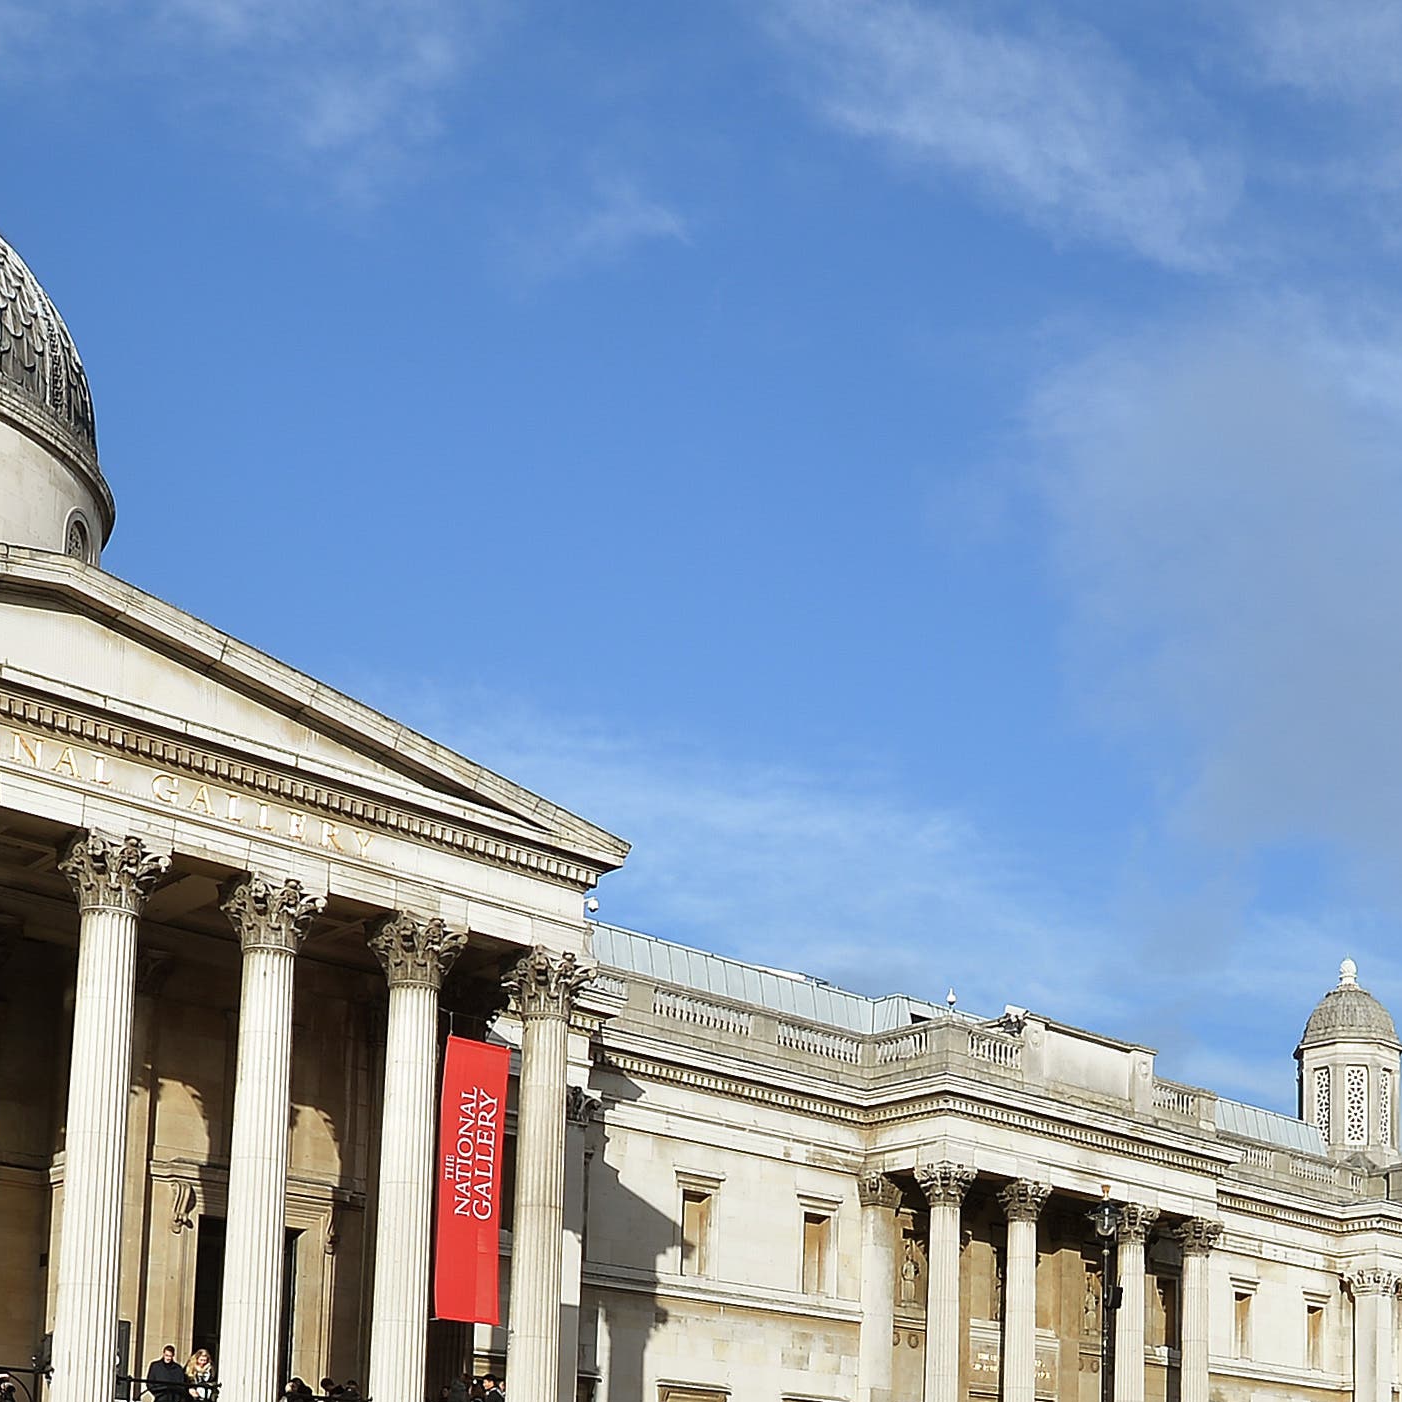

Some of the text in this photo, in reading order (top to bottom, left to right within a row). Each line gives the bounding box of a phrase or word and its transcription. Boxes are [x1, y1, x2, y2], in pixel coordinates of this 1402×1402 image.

[151, 773, 376, 859] GALLERY
[444, 1154, 455, 1181] THE
[454, 1086, 478, 1217] NATIONAL
[472, 1088, 498, 1221] GALLERY
